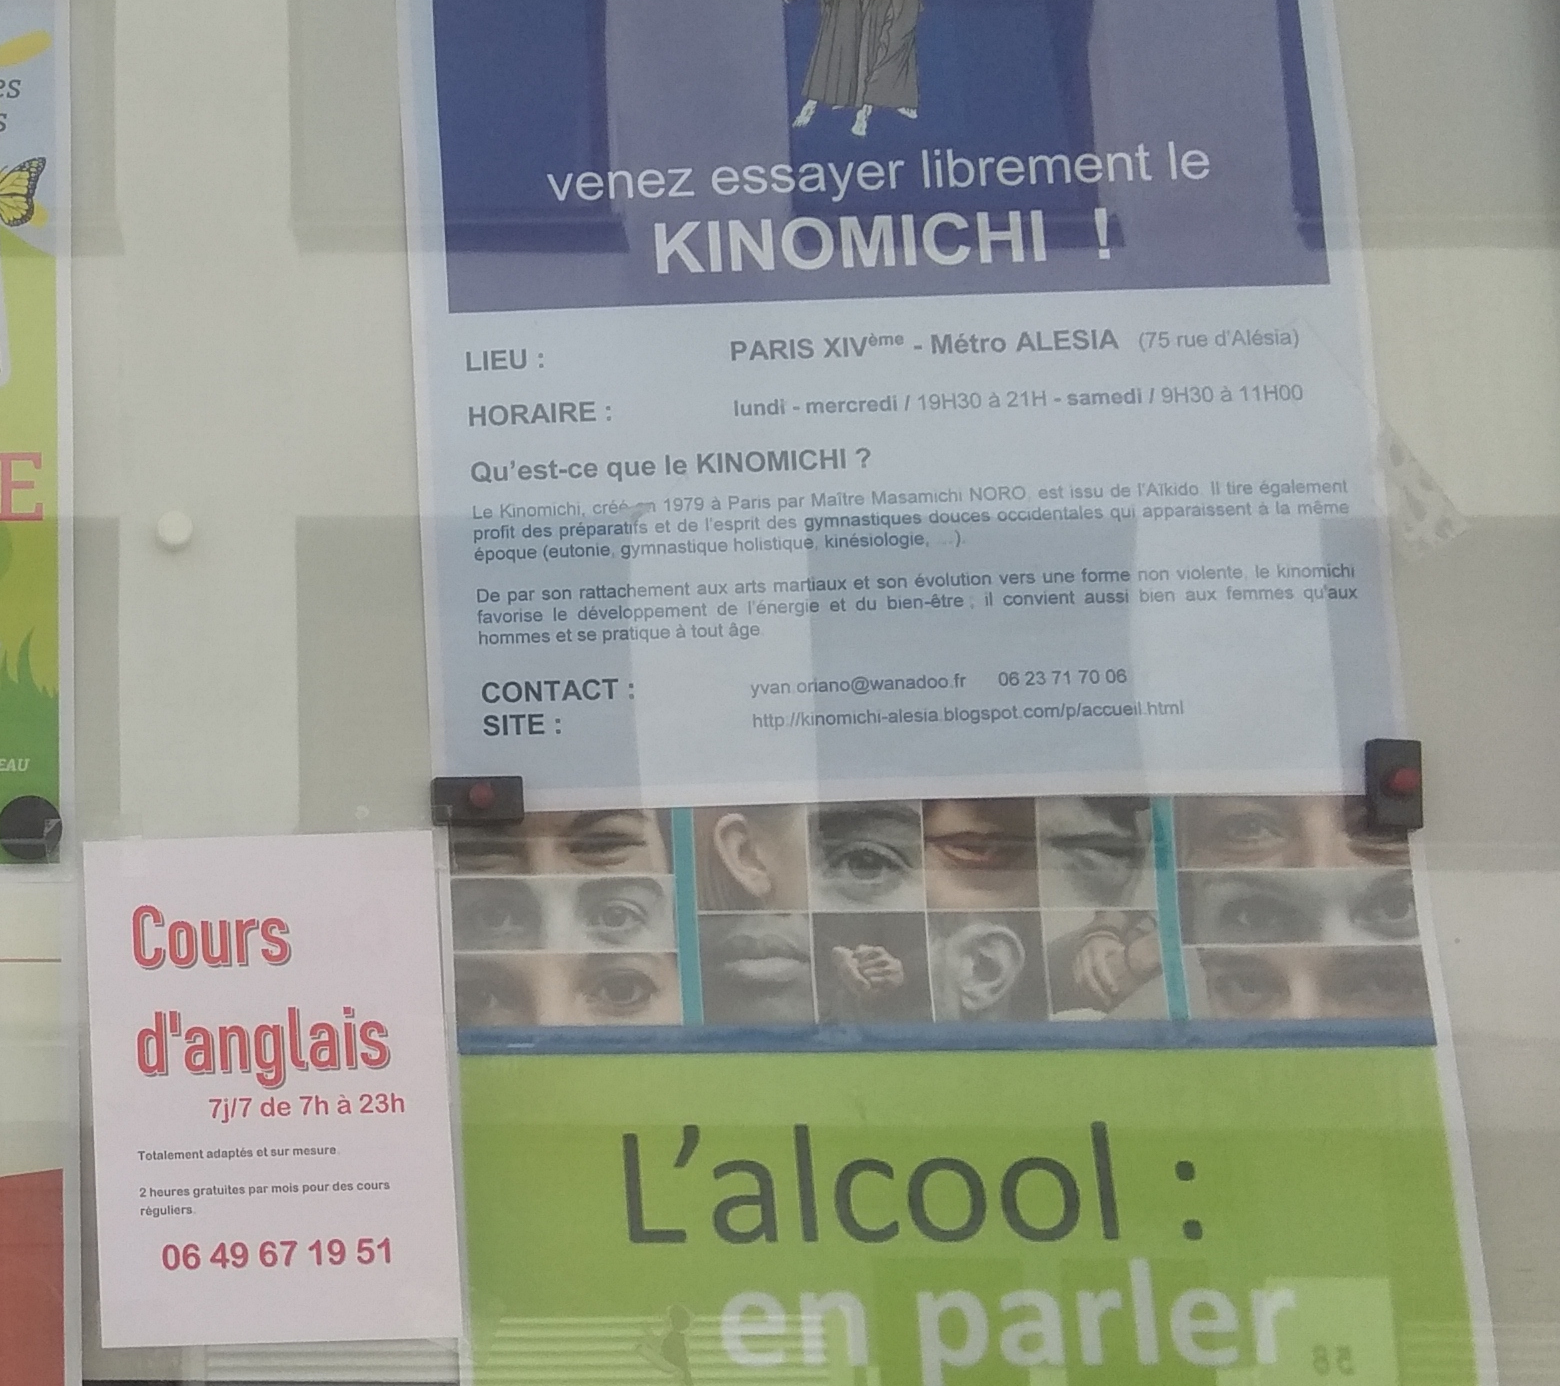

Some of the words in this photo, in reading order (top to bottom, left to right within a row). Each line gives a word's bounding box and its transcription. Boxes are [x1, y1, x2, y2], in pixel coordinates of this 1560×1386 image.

[547, 161, 695, 204] venez
[710, 158, 904, 202] essayer
[920, 145, 1153, 190] librement
[654, 209, 1049, 276] KINOMICHI
[465, 348, 528, 373] LIEU
[730, 338, 814, 362] PARIS
[930, 330, 1007, 355] Métro
[1016, 329, 1119, 353] ALESIA
[468, 400, 596, 428] HORAIRE
[734, 398, 787, 418] lundi
[805, 394, 898, 415] mercredi
[917, 392, 981, 412] 19H30
[696, 448, 846, 475] KINOMICHI
[481, 678, 619, 704] CONTACT
[483, 714, 545, 737] SITE
[131, 904, 293, 971] Cours
[136, 1006, 391, 1090] d'anglais
[208, 1097, 253, 1123] 7j/7
[138, 1149, 204, 1162] Totalement
[206, 1147, 253, 1162] adaptés
[622, 1120, 1121, 1246] L'alcool
[719, 1286, 869, 1368] en
